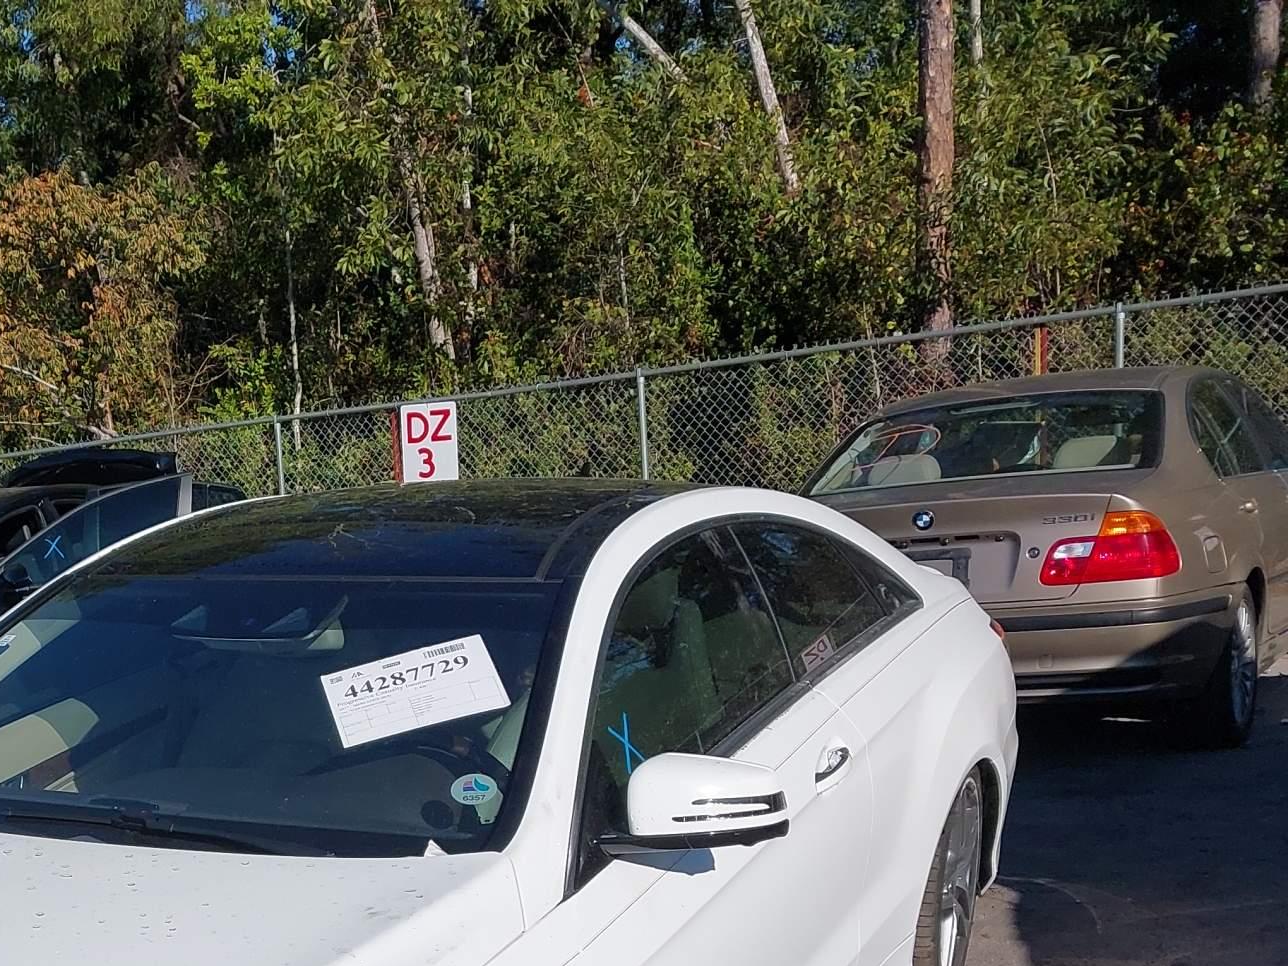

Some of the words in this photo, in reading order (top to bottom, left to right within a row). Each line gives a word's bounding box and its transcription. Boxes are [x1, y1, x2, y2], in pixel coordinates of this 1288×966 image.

[406, 408, 453, 444] DZ
[417, 447, 436, 479] 3
[1041, 512, 1096, 525] 330i
[343, 654, 470, 698] 44287729
